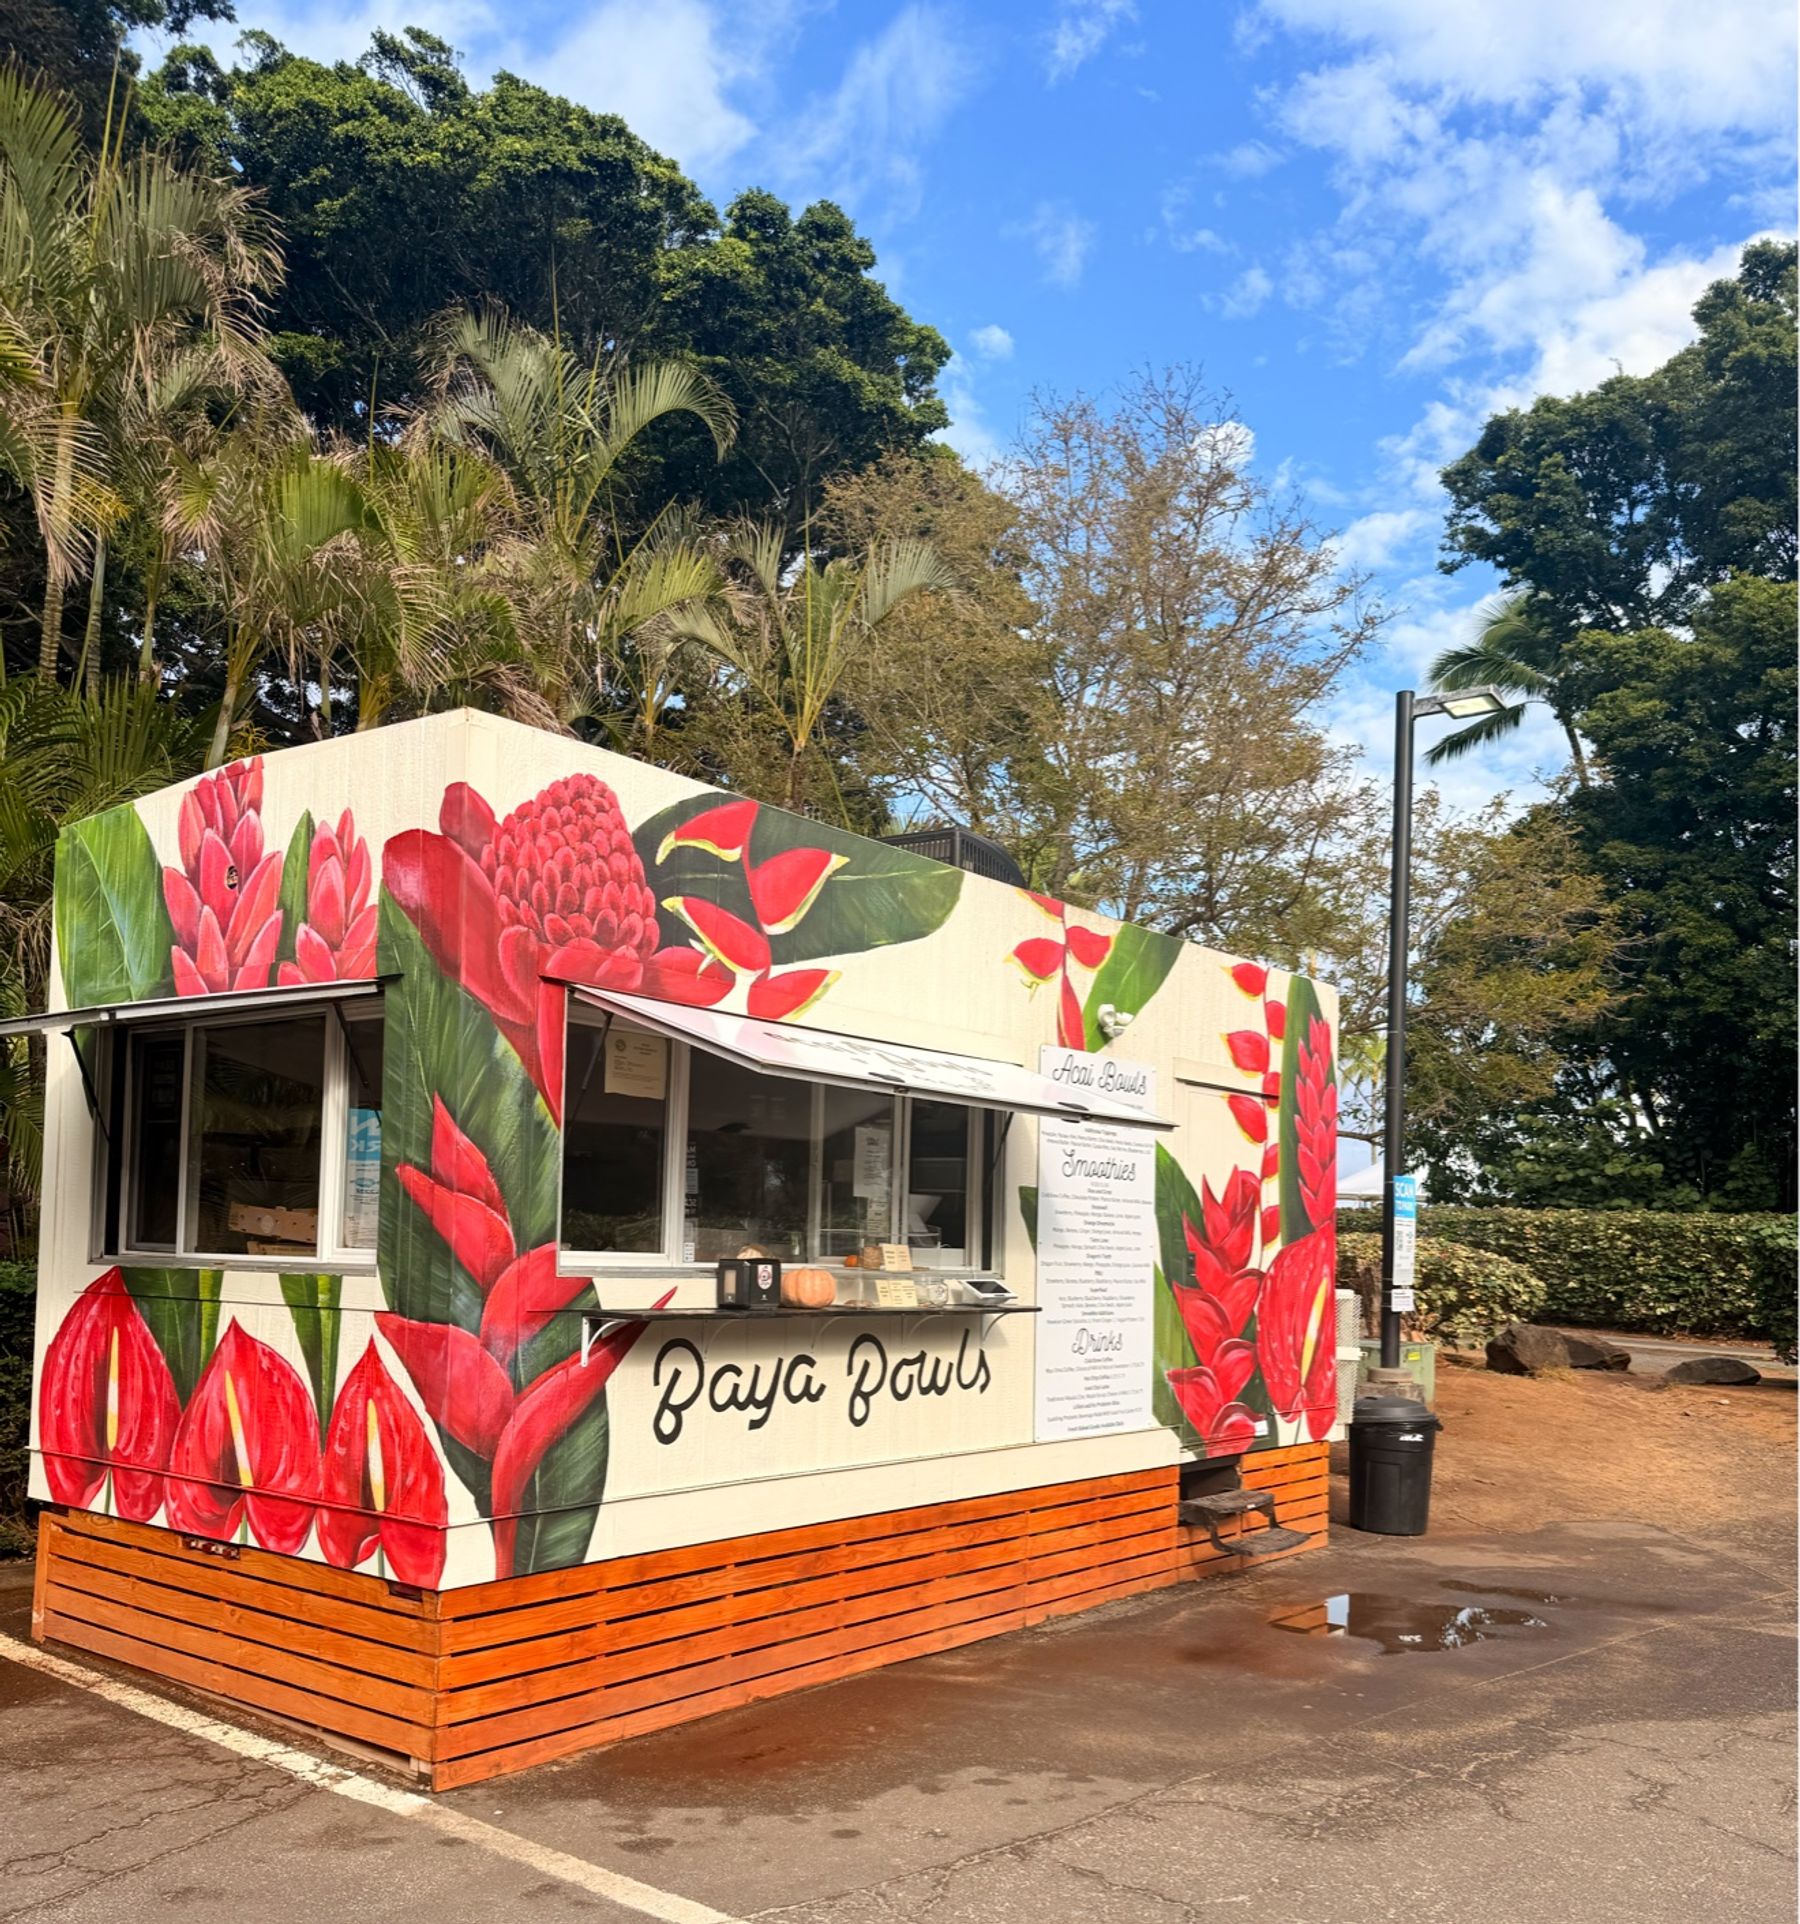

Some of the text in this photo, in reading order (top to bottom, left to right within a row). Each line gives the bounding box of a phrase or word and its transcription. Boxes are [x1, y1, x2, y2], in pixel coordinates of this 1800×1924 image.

[1098, 1061, 1147, 1095] Bowls
[1062, 1148, 1136, 1181] Smoothies
[1071, 1327, 1123, 1355] Drinks
[847, 1328, 992, 1427] Bowls
